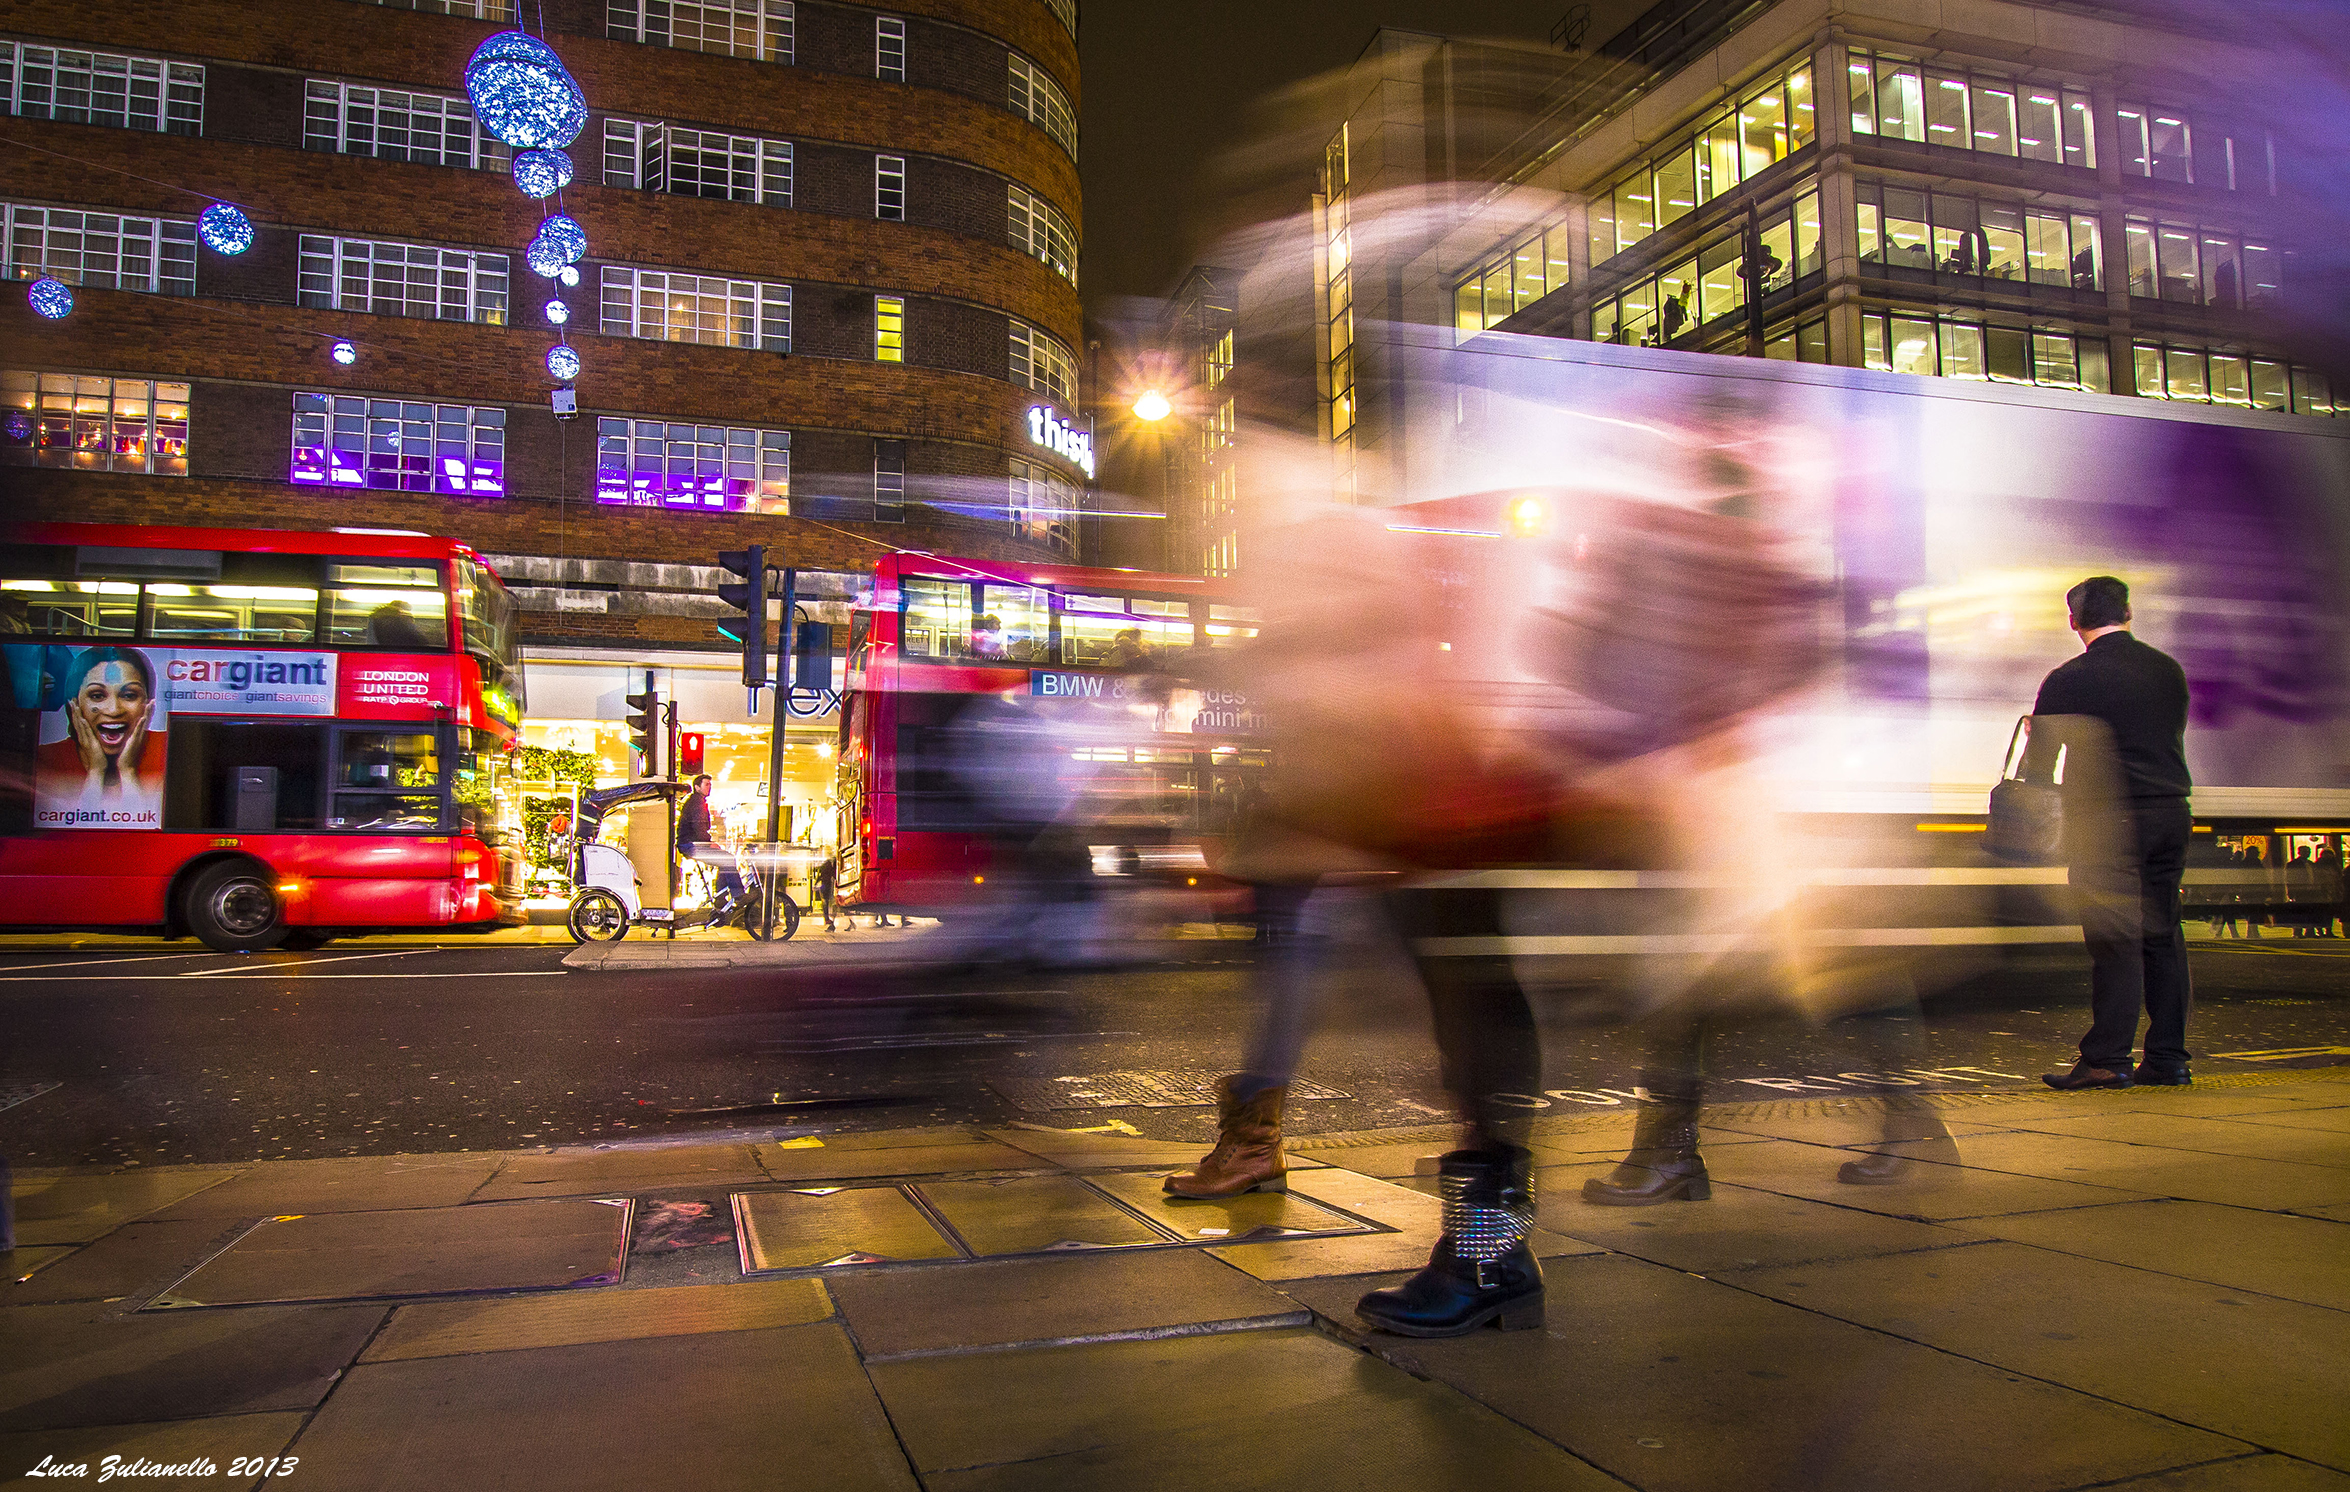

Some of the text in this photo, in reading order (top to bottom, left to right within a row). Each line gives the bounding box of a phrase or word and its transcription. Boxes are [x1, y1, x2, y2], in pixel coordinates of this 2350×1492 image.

[167, 655, 327, 690] cargiant
[364, 671, 429, 682] LONDON
[363, 684, 428, 695] UNITED
[1042, 674, 1126, 699] BMW &
[165, 689, 327, 705] giantchoice giantsavings
[1195, 706, 1241, 728] mini
[38, 808, 156, 825] cargiant.co.uk
[2245, 835, 2263, 845] 20%
